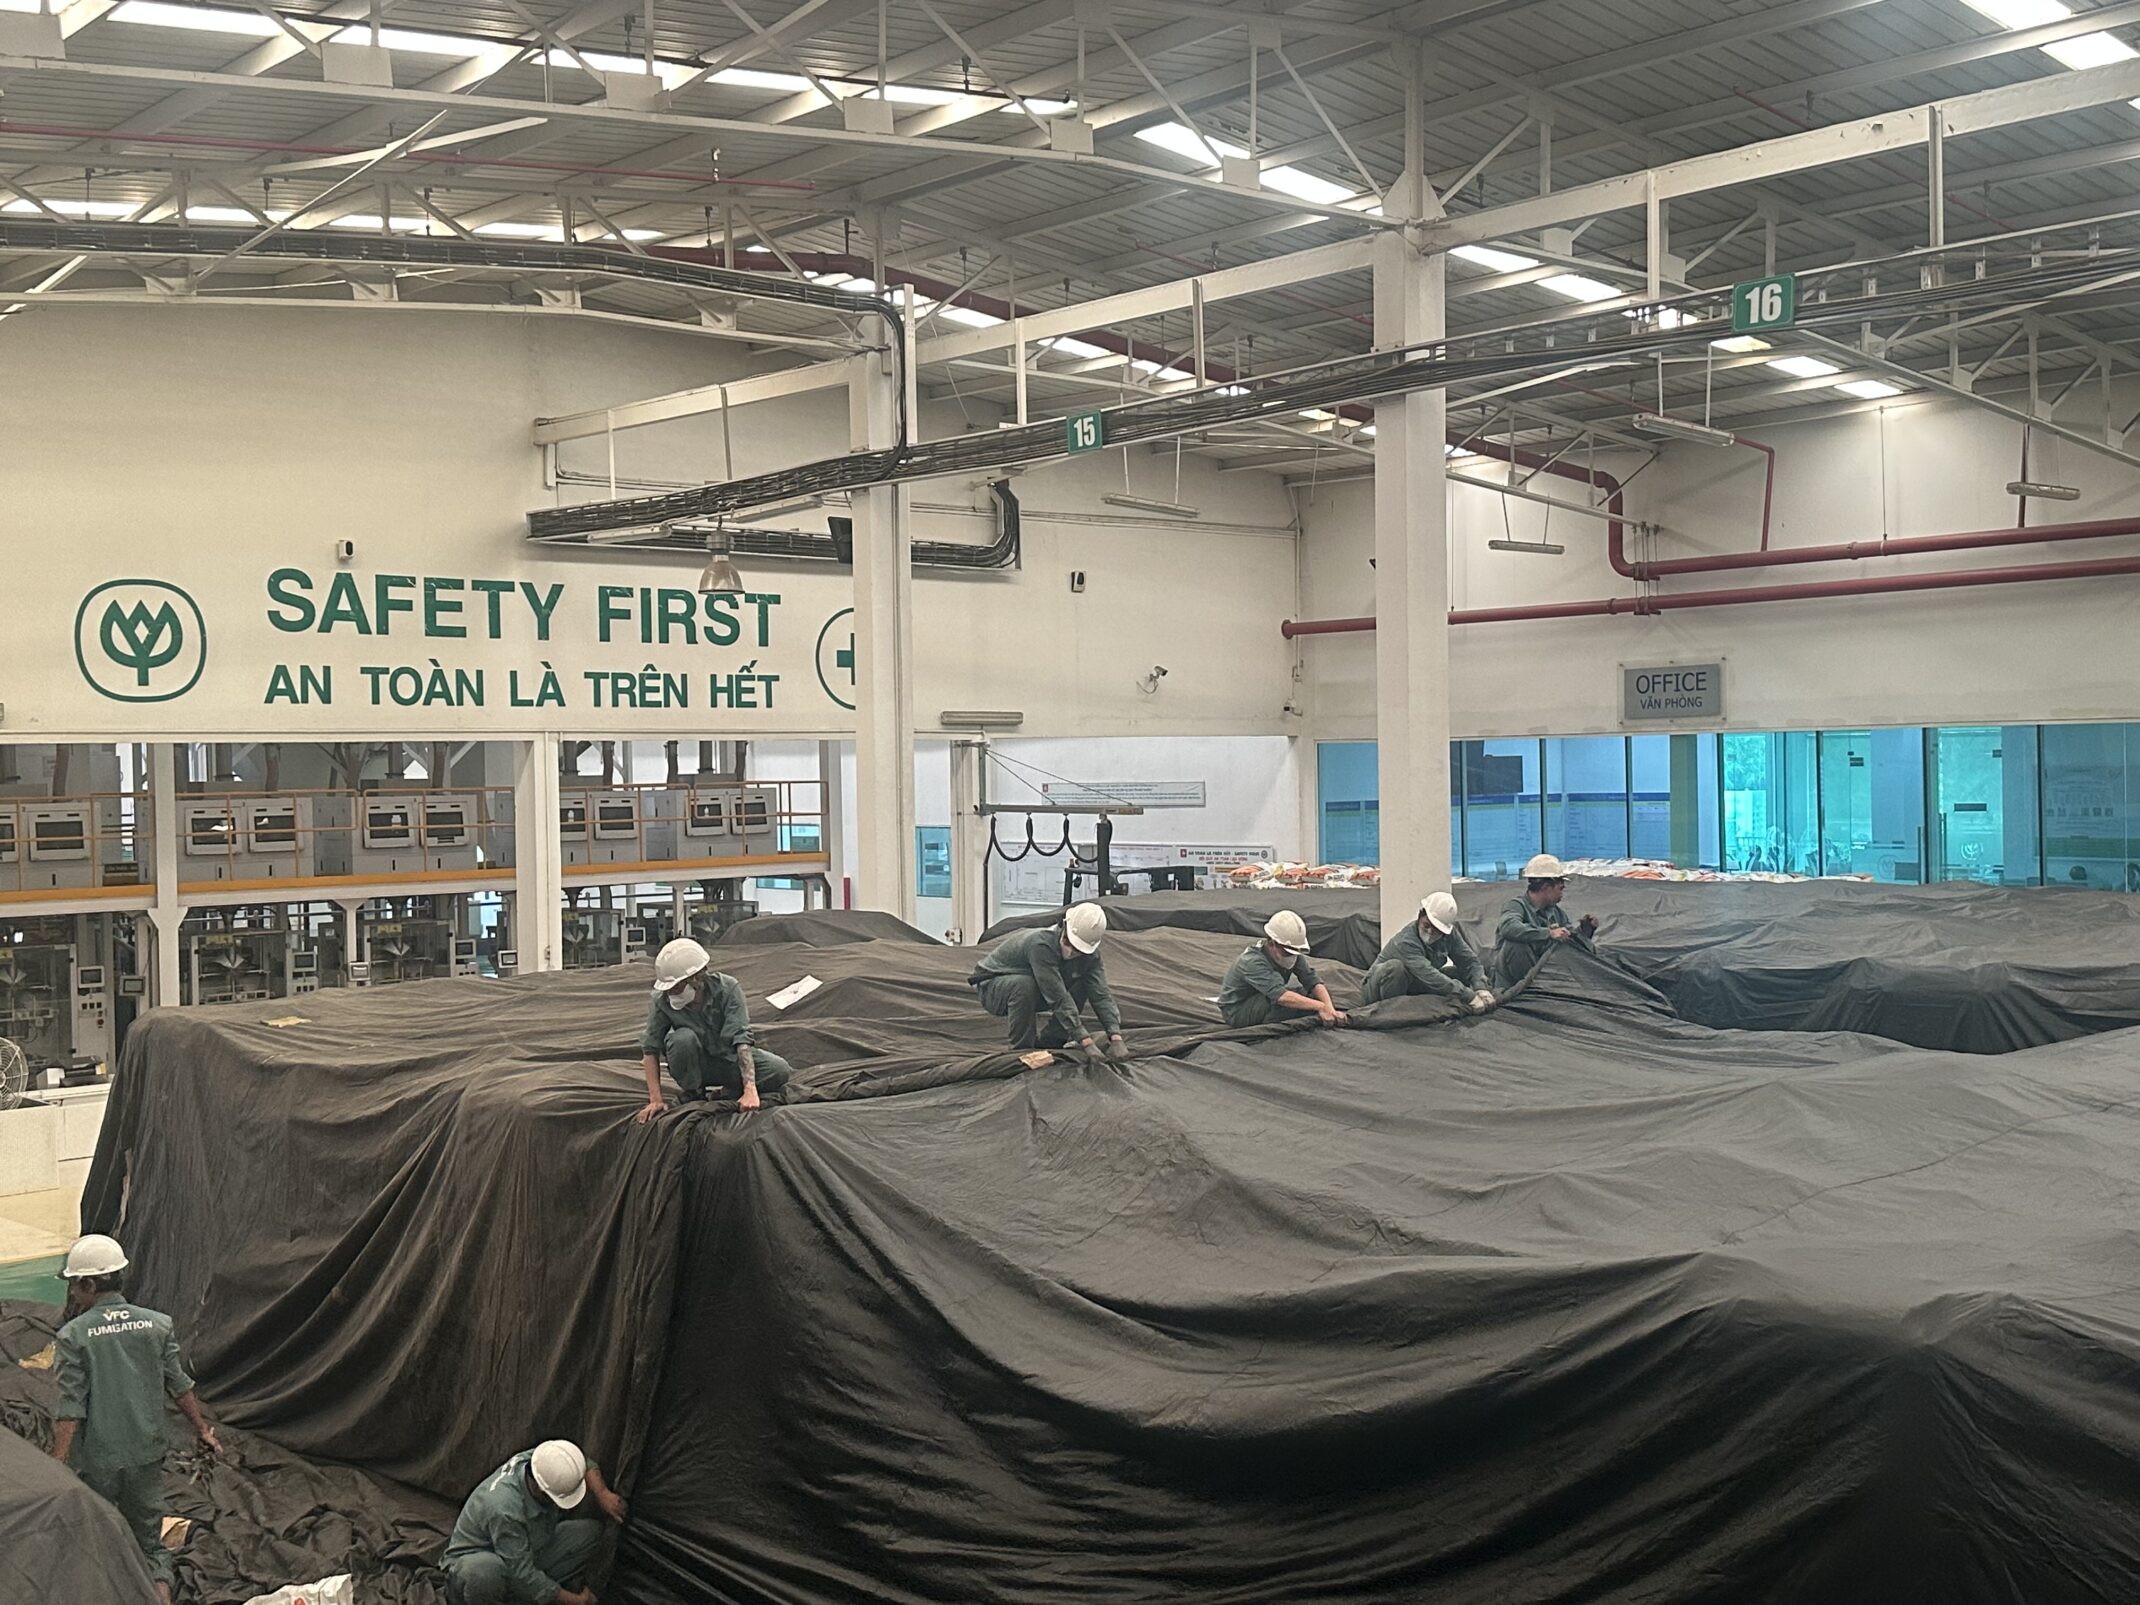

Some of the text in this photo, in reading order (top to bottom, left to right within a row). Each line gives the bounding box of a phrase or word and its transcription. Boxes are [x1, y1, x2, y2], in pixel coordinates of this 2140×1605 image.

[1745, 282, 1783, 324] 16
[1073, 416, 1096, 448] 15
[268, 568, 781, 647] SAFETY FIRST
[264, 659, 780, 708] AN TOÀN LÀ TRÊN HẾT
[1636, 671, 1707, 695] OFFICE
[1640, 694, 1703, 710] VĂN PHÒNG
[87, 1320, 153, 1337] FUMIGATION
[102, 1308, 130, 1321] VFC
